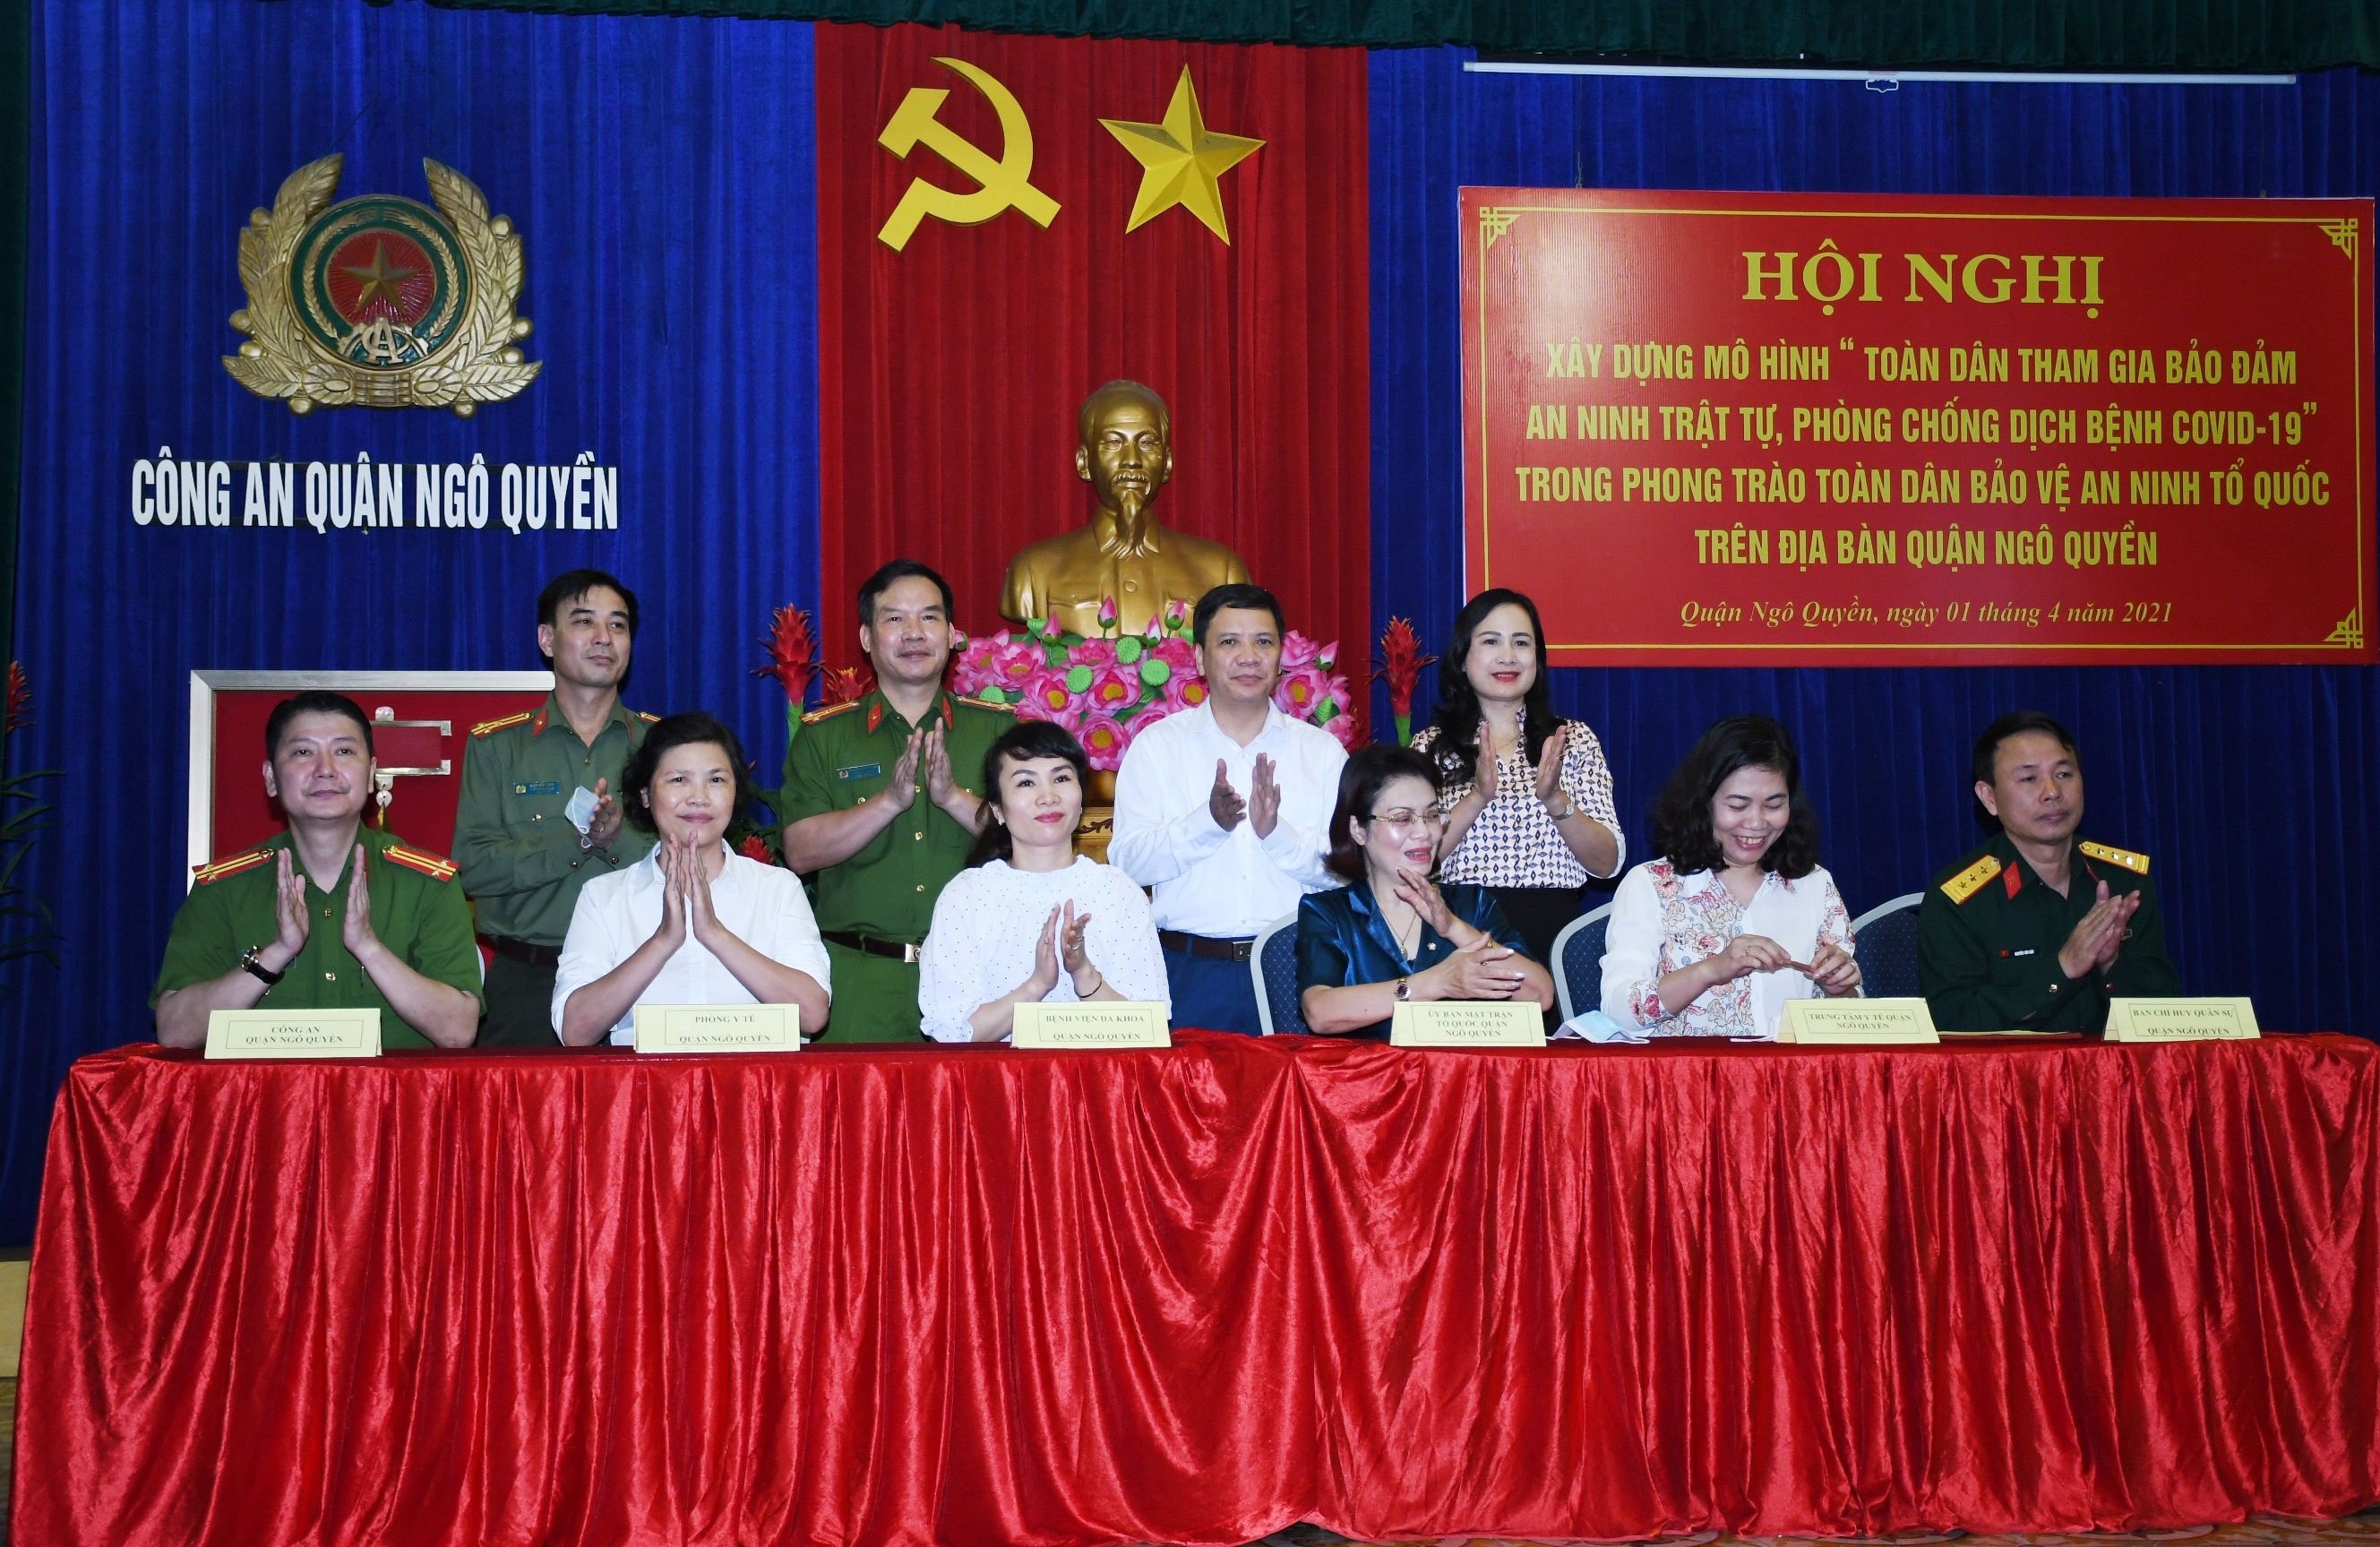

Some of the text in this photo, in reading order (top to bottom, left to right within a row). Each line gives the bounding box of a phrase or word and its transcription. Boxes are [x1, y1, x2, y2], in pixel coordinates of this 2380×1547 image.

[1742, 237, 2104, 319] HỘI NGHỊ
[1545, 336, 1602, 378] XÂY
[1614, 340, 1694, 386] DỰNG
[1704, 338, 1749, 381] MÔ
[1759, 338, 1829, 381] HÌNH
[1863, 339, 1939, 382] TOÀN
[1949, 340, 2008, 382] DÂN
[2018, 348, 2099, 384] THAM
[2109, 348, 2156, 384] GIA
[2166, 339, 2222, 384] BẢO
[2231, 339, 2297, 384] ĐẢM
[1526, 405, 1568, 440] AN
[1578, 406, 1651, 441] NINH
[1659, 399, 1731, 449] TRẬT
[1739, 403, 1783, 450] TỰ,
[1793, 399, 1892, 443] PHÒNG
[1902, 396, 2000, 443] CHỐNG
[2010, 408, 2076, 451] DỊCH
[2086, 402, 2162, 451] BỆNH
[132, 445, 230, 527] CÔNG
[243, 461, 294, 527] AN
[416, 452, 489, 529] NGÔ
[501, 451, 618, 535] QUYỀN
[1515, 458, 2330, 512] TRONG PHONG TRÀO TOÀN DÂN BẢO VỆ AN NINH TỔ QUỐC
[1695, 520, 2157, 572] TRÊN ĐỊA BÀN QUẬN NGÔ QUYỀN
[1680, 597, 2172, 629] Quận Ngô Quyền, ngày 01 tháng 4 năm 2021
[695, 1014, 731, 1023] PHÒNG
[1045, 1014, 1072, 1024] BỆNH
[1074, 1014, 1098, 1024] VIỆN
[271, 1024, 303, 1034] CÔNG
[1836, 1021, 1856, 1029] NGÔ
[1445, 1029, 1465, 1037] NGÔ
[2177, 1027, 2196, 1035] NGÔ
[245, 1036, 276, 1045] QUẬN
[279, 1035, 303, 1044] NGÔ
[680, 1036, 708, 1044] QUẬN
[711, 1034, 733, 1043] NGÔ
[1053, 1033, 1081, 1042] QUẬN
[1083, 1032, 1104, 1040] NGÔ
